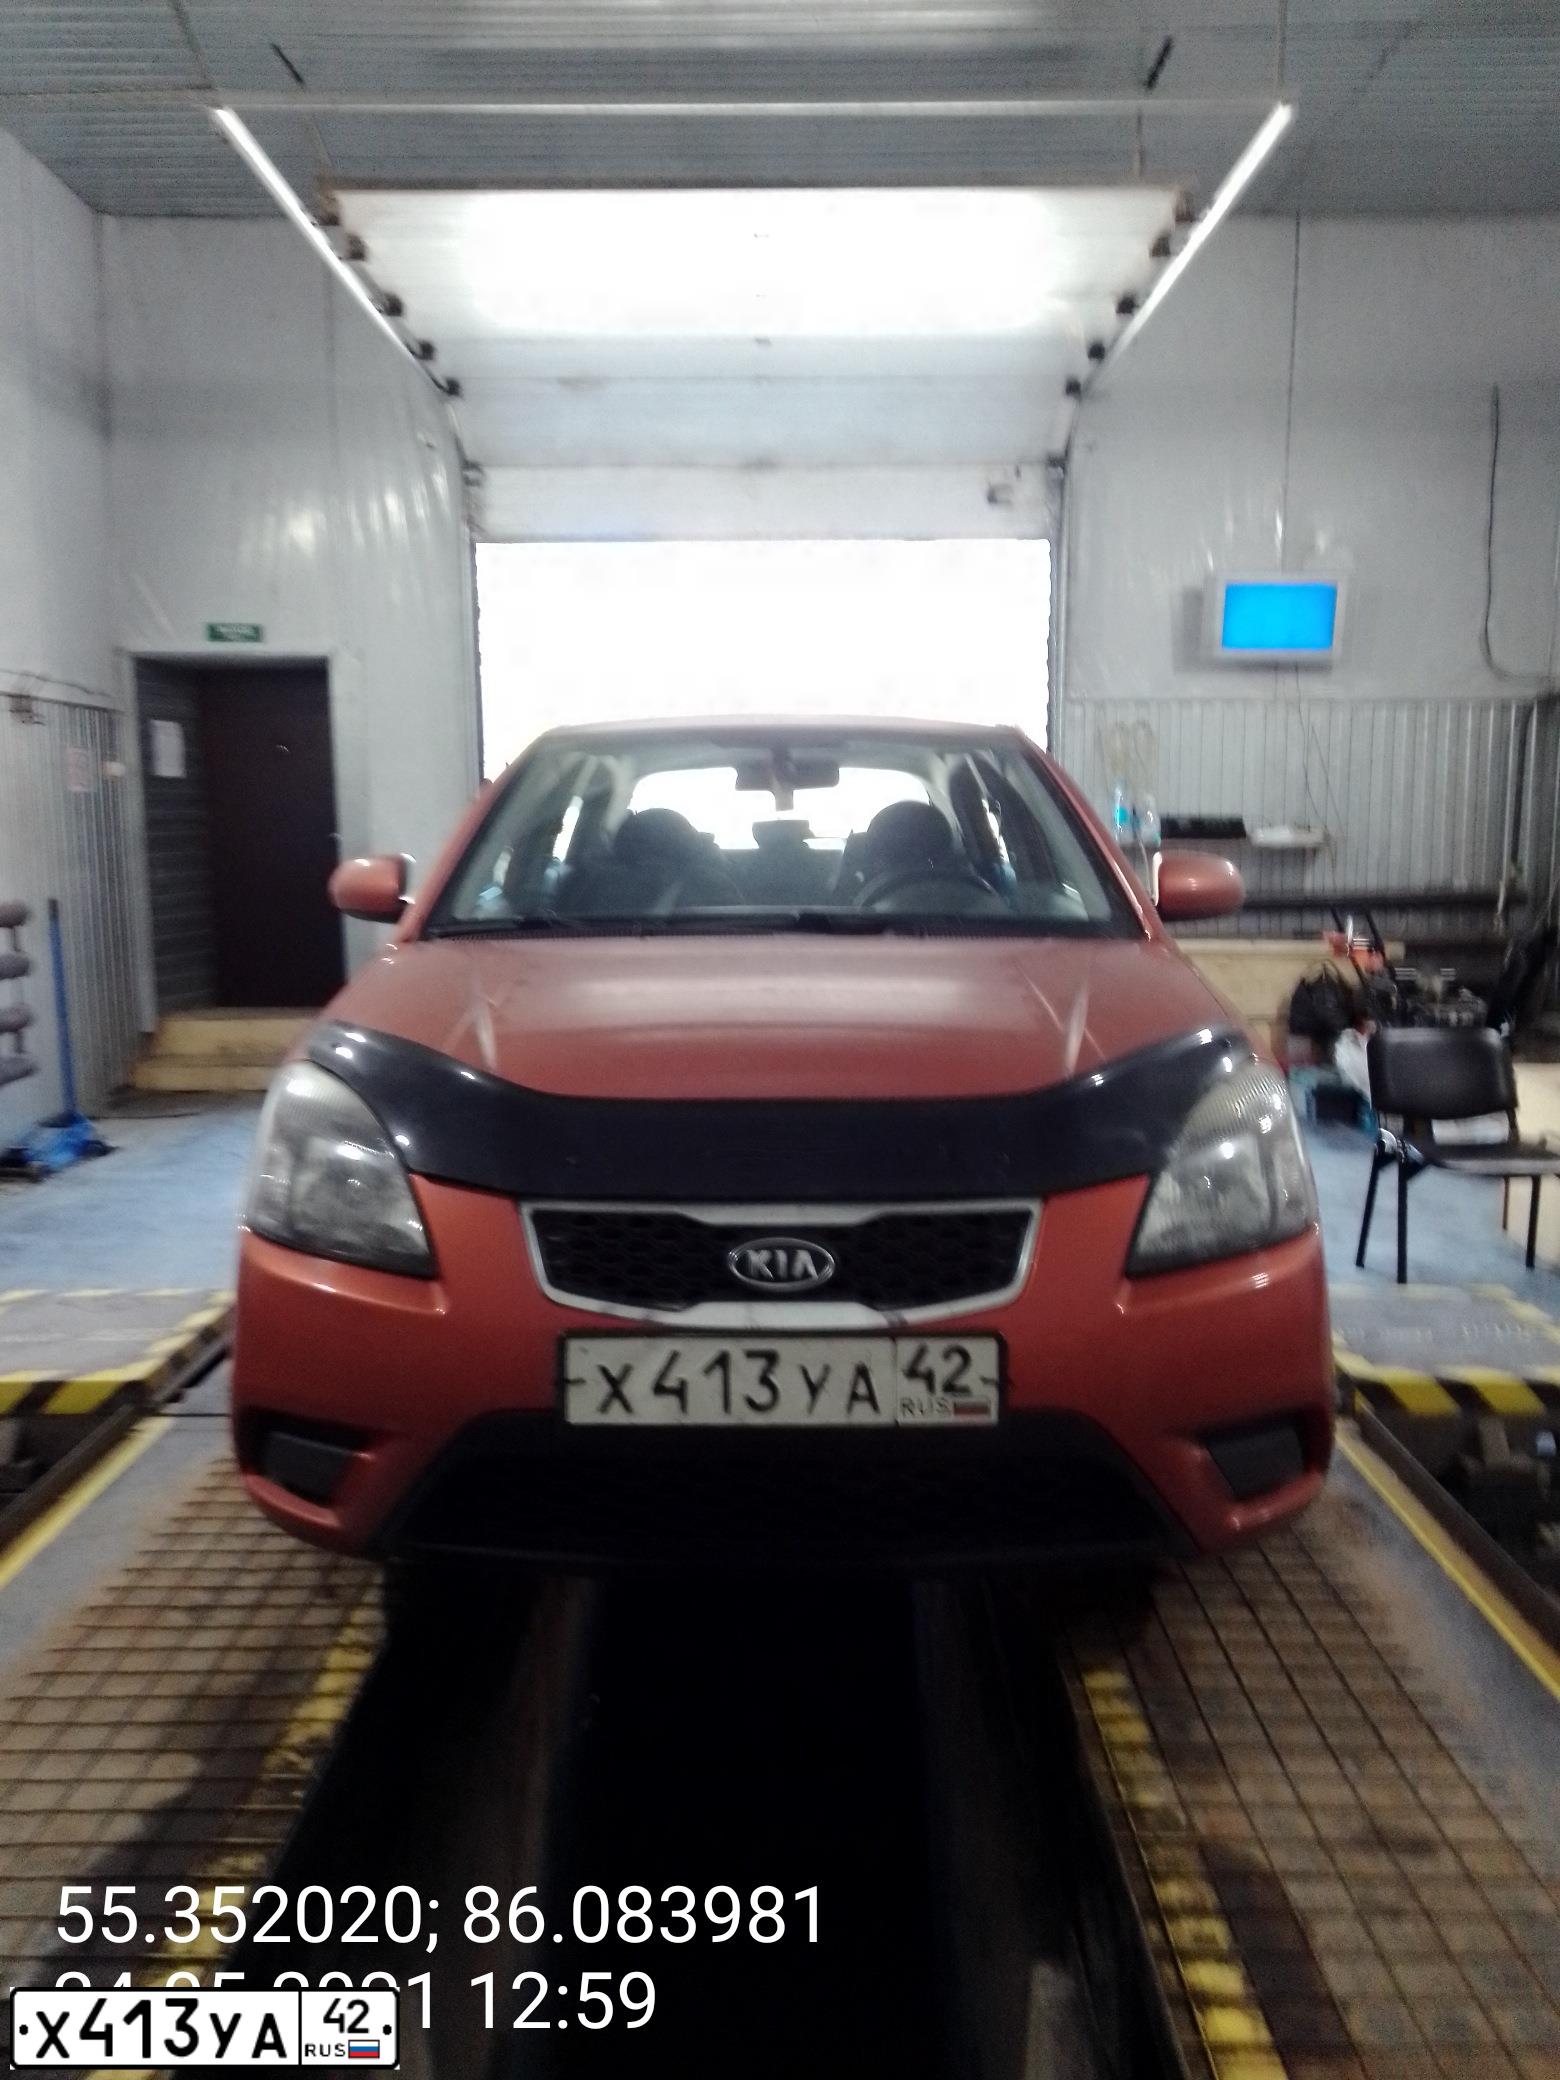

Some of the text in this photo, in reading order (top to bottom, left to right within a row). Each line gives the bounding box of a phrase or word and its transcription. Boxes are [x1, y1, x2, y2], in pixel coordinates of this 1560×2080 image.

[745, 1249, 819, 1280] KIA
[902, 1344, 972, 1395] 42
[900, 1397, 950, 1417] RUS
